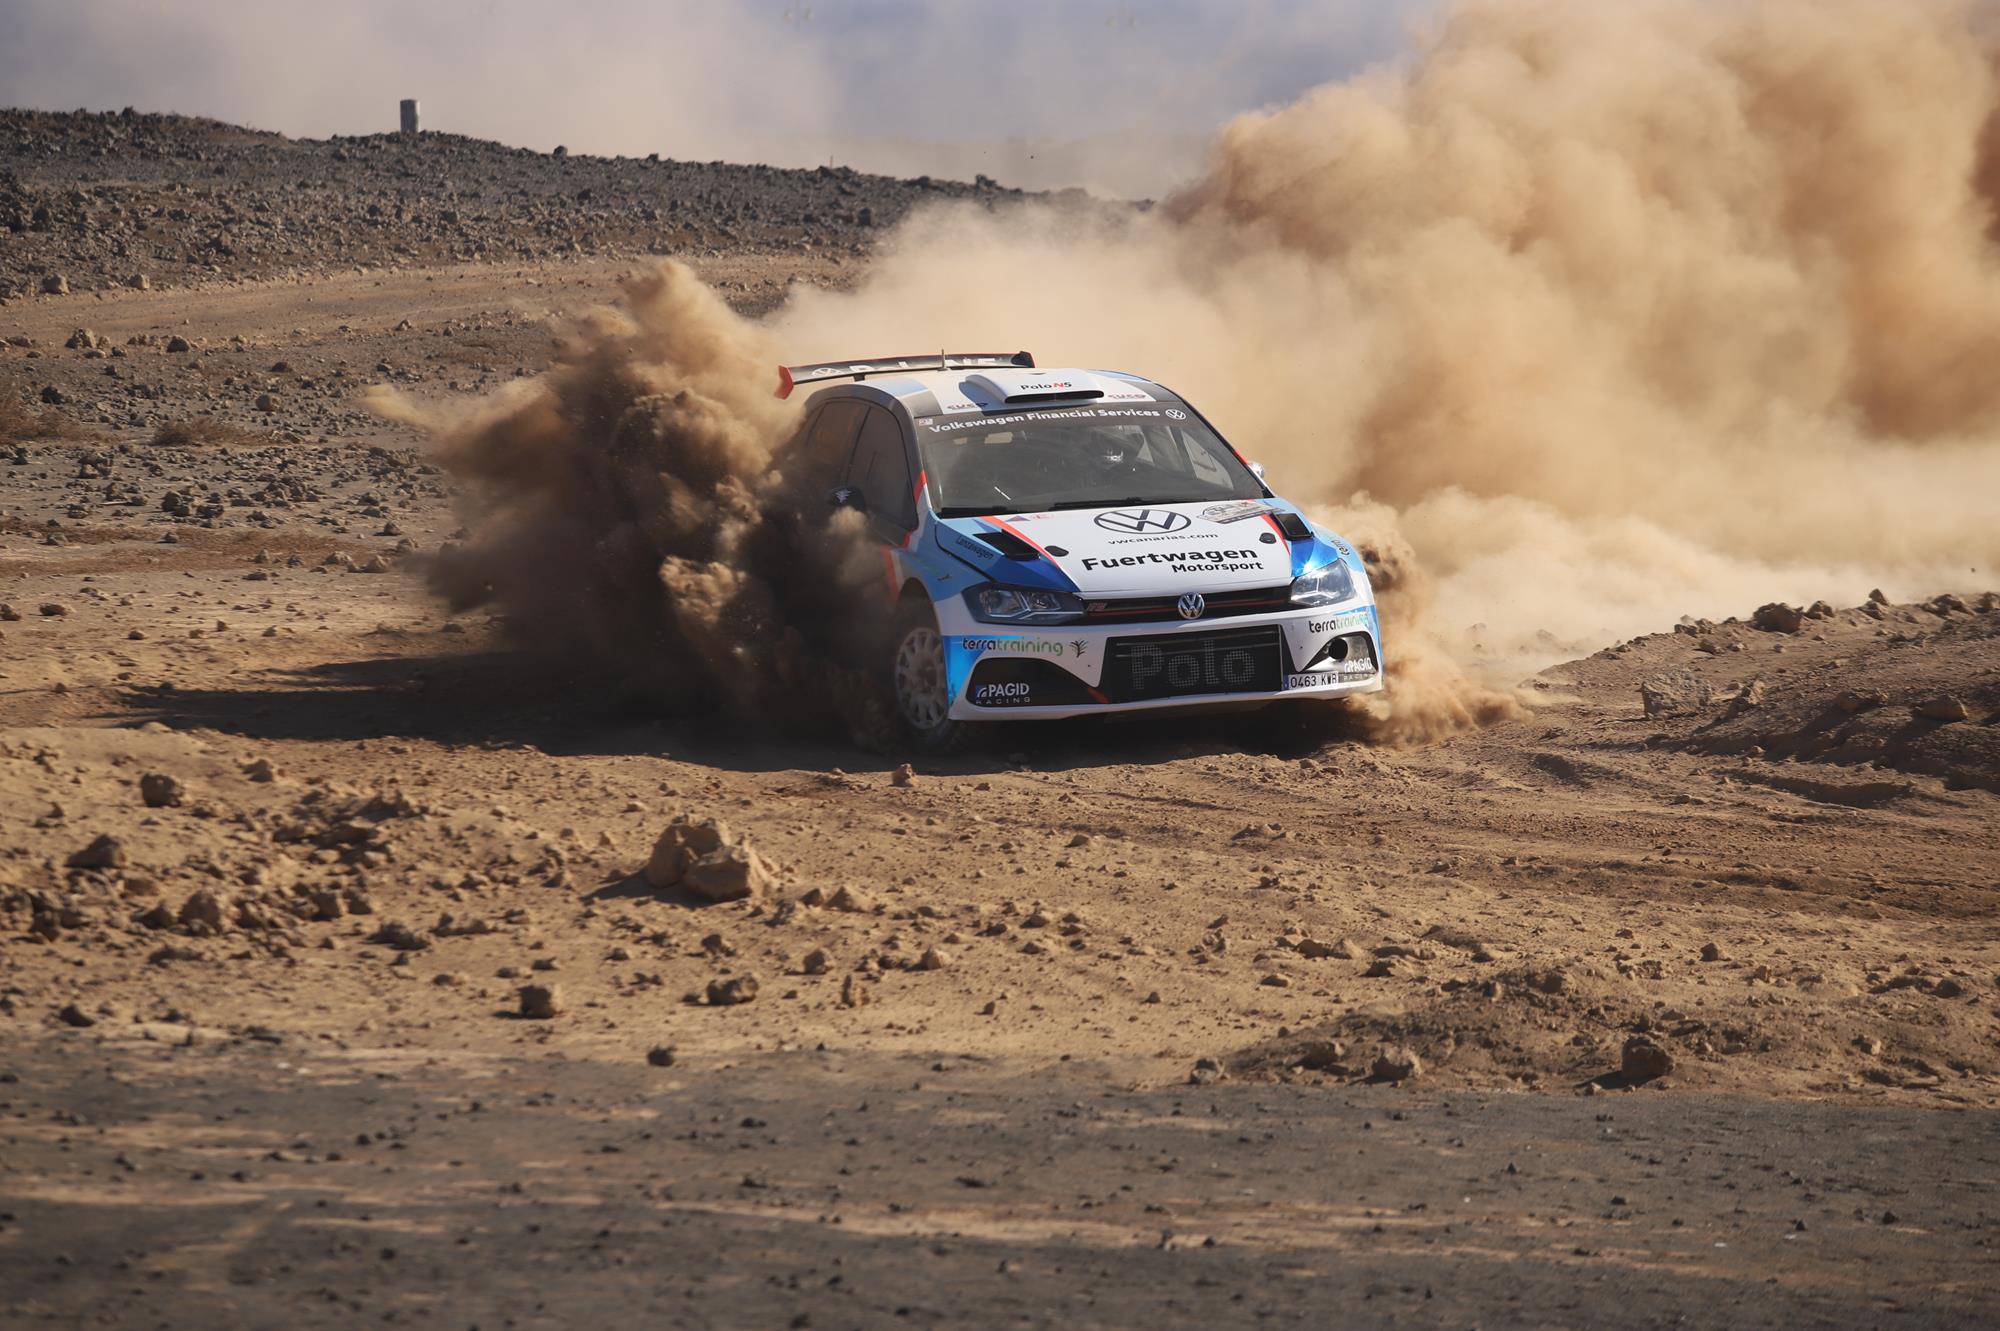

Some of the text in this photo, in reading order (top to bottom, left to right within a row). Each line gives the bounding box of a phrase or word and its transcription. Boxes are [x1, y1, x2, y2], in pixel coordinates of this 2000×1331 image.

[929, 414, 1025, 433] Volkswagen
[1027, 409, 1096, 422] Financial
[1098, 408, 1161, 417] Services
[1107, 532, 1218, 545] vwcanarias.com
[1081, 549, 1258, 571] Fuertwagen
[1171, 561, 1264, 573] Motorsport
[963, 637, 1063, 656] terratraining
[1131, 639, 1255, 690] Polo
[1348, 657, 1372, 673] PAGID
[1290, 675, 1317, 688] 0463
[988, 682, 1030, 697] PAGID
[976, 696, 1031, 705] RACING
